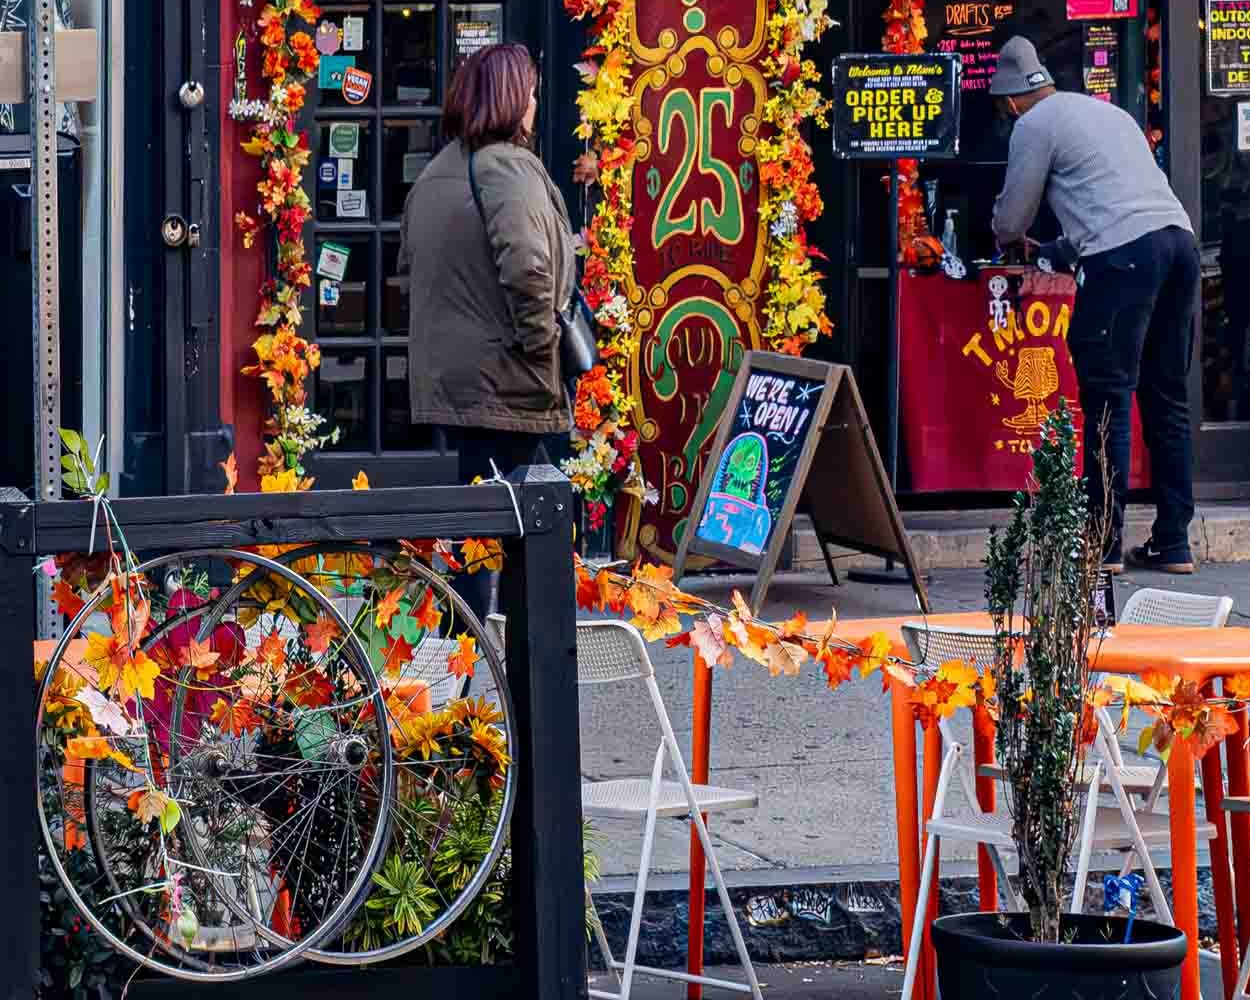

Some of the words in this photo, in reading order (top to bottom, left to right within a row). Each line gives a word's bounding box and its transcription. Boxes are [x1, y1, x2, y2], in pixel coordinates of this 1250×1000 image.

[945, 3, 990, 26] DRAFTS
[846, 88, 916, 106] ORDER
[924, 87, 944, 104] &
[853, 105, 903, 122] PICK
[912, 104, 942, 121] UP
[870, 120, 924, 138] HERE
[652, 86, 744, 248] 25
[746, 373, 796, 405] WE'RE
[754, 401, 810, 436] OPEN!
